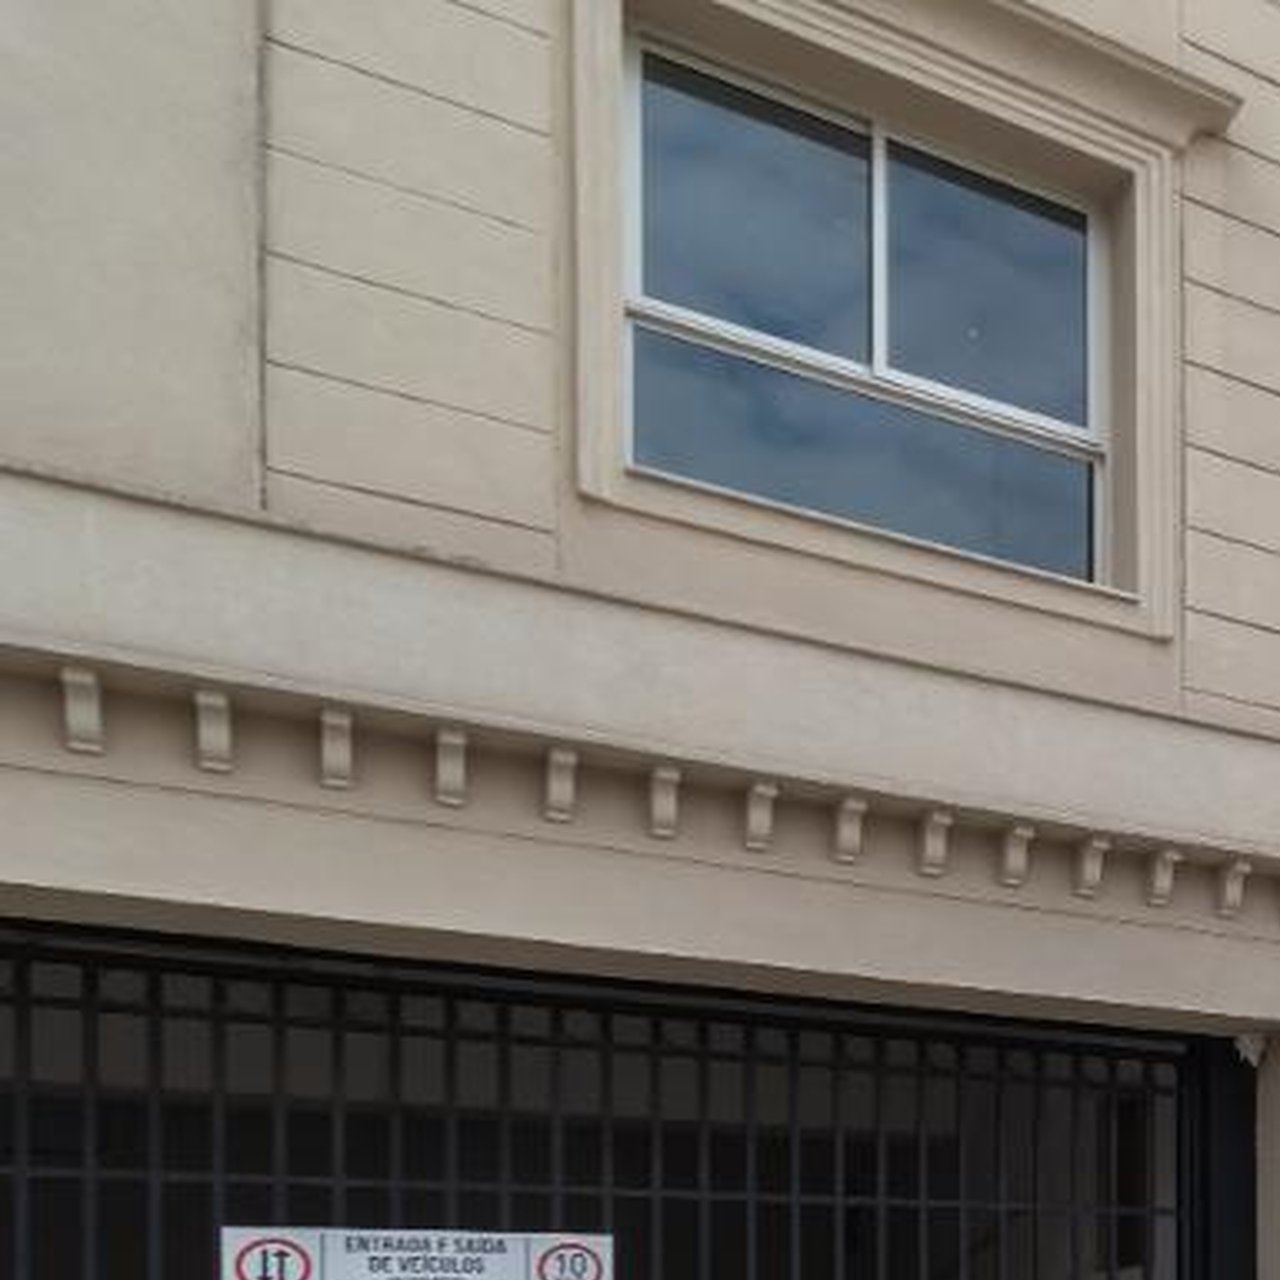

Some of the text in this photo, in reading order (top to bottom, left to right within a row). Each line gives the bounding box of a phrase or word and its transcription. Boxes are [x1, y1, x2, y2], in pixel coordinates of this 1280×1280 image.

[345, 1236, 431, 1254] ENTRADA
[368, 1256, 393, 1273] DE
[555, 1253, 587, 1280] 10
